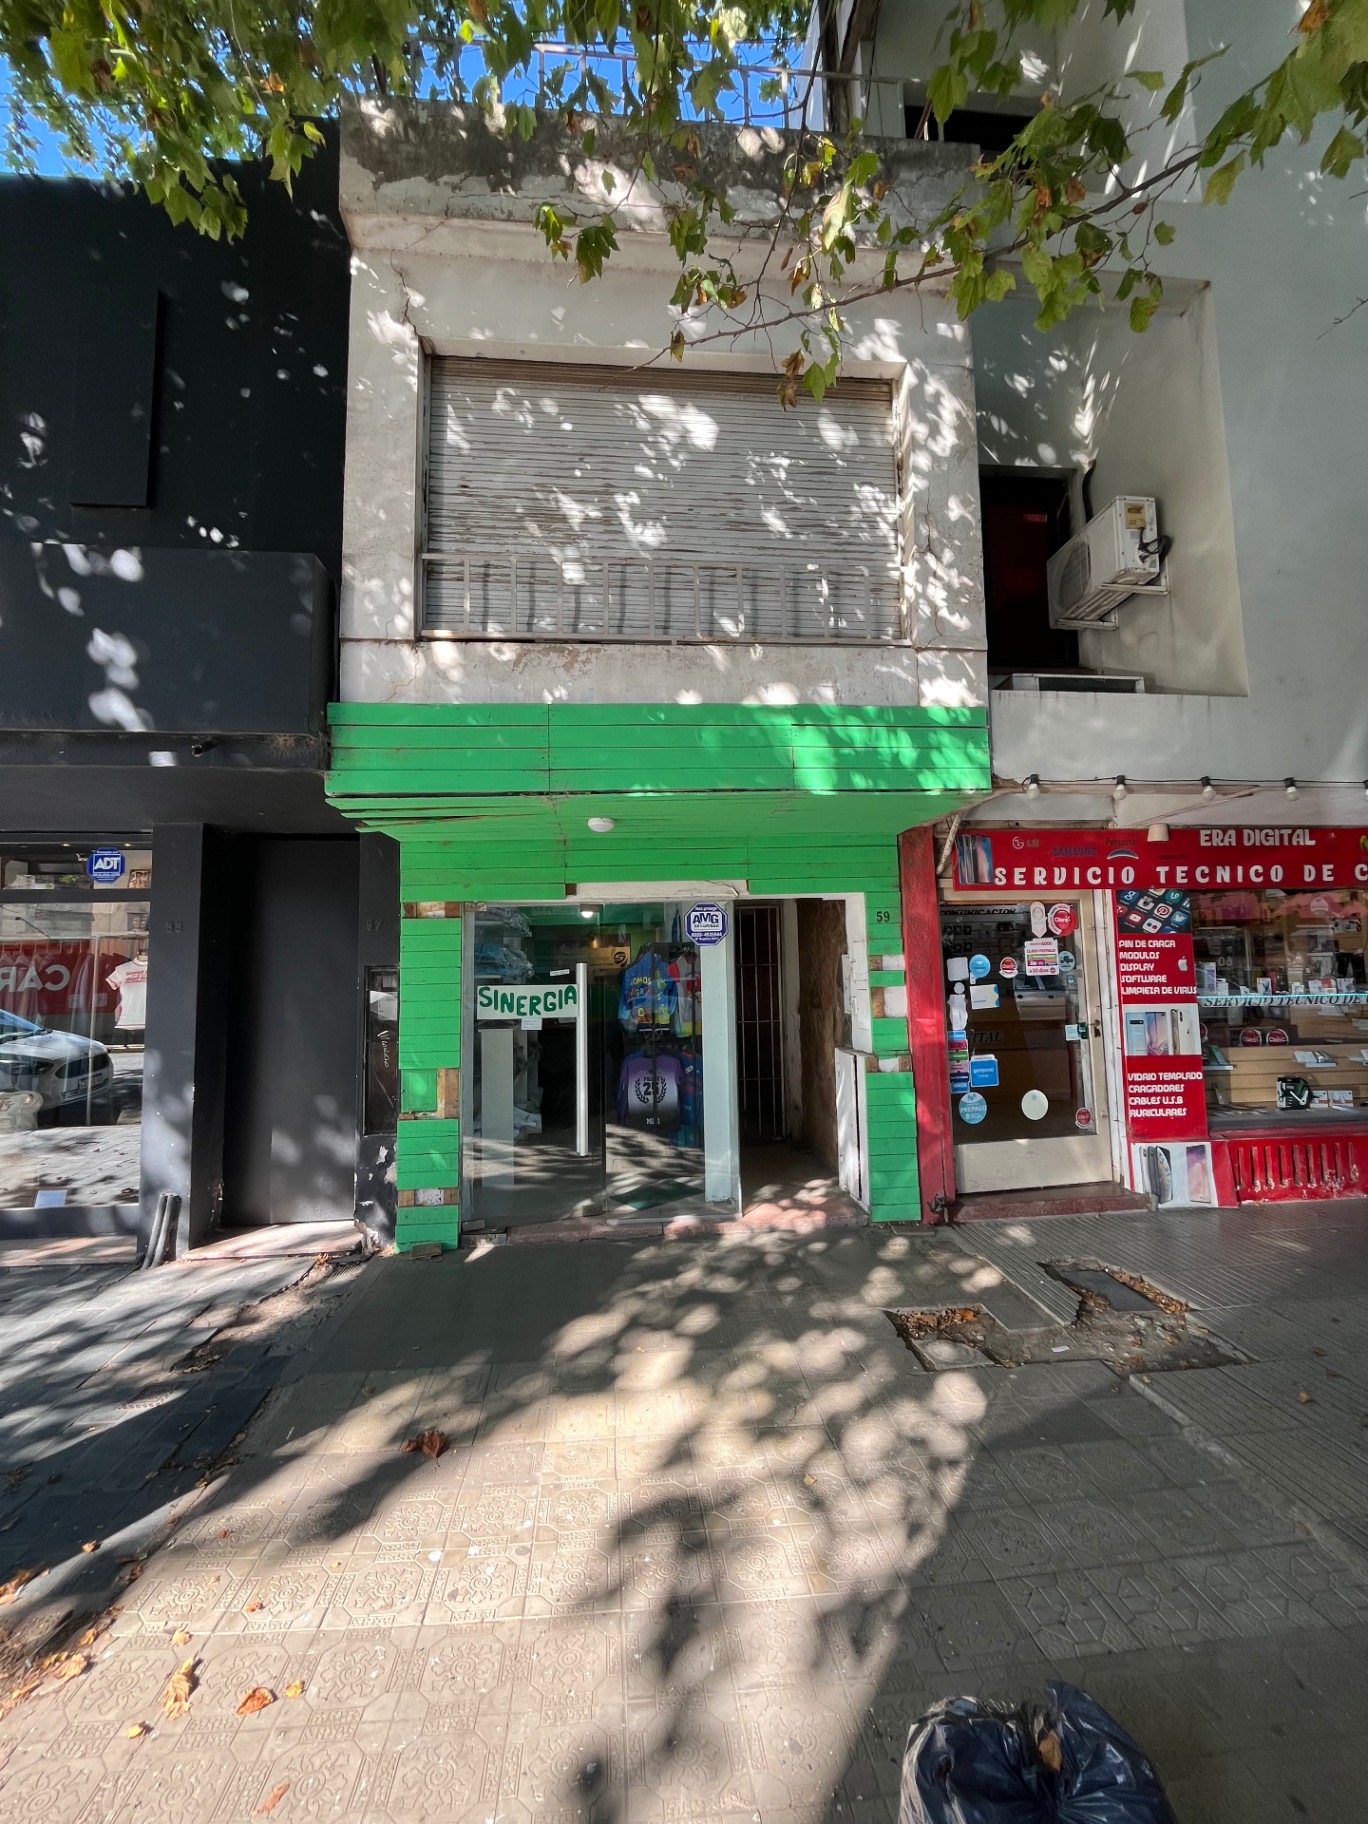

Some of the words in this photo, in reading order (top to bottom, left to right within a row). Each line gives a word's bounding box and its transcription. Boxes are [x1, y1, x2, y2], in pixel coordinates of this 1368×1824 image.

[1200, 828, 1237, 847] ERA
[1243, 827, 1316, 846] DIGITAL
[94, 857, 120, 870] ADT
[994, 866, 1135, 886] SERVICIO
[1156, 865, 1284, 884] TECNICO
[1303, 863, 1334, 883] DE
[692, 912, 719, 923] AMG
[875, 910, 891, 924] 59
[1118, 940, 1133, 948] PIN
[1135, 940, 1147, 948] DE
[1147, 940, 1176, 948] CARGA
[1119, 951, 1160, 960] MODULOS
[1120, 963, 1155, 971] DISPLAY
[1121, 974, 1167, 983] SOFTWARE
[1121, 986, 1160, 995] LIMPIEZA
[1161, 986, 1173, 995] DE
[1174, 986, 1198, 995] VIRUS
[478, 985, 578, 1016] SINERGIA
[1127, 1072, 1157, 1081] VIDRIO
[1158, 1071, 1203, 1081] TEMPLADO
[1128, 1084, 1185, 1093] CARGADORES
[1129, 1096, 1161, 1105] CABLES
[1162, 1096, 1184, 1105] U.S.B
[1130, 1107, 1187, 1118] AURICULARES
